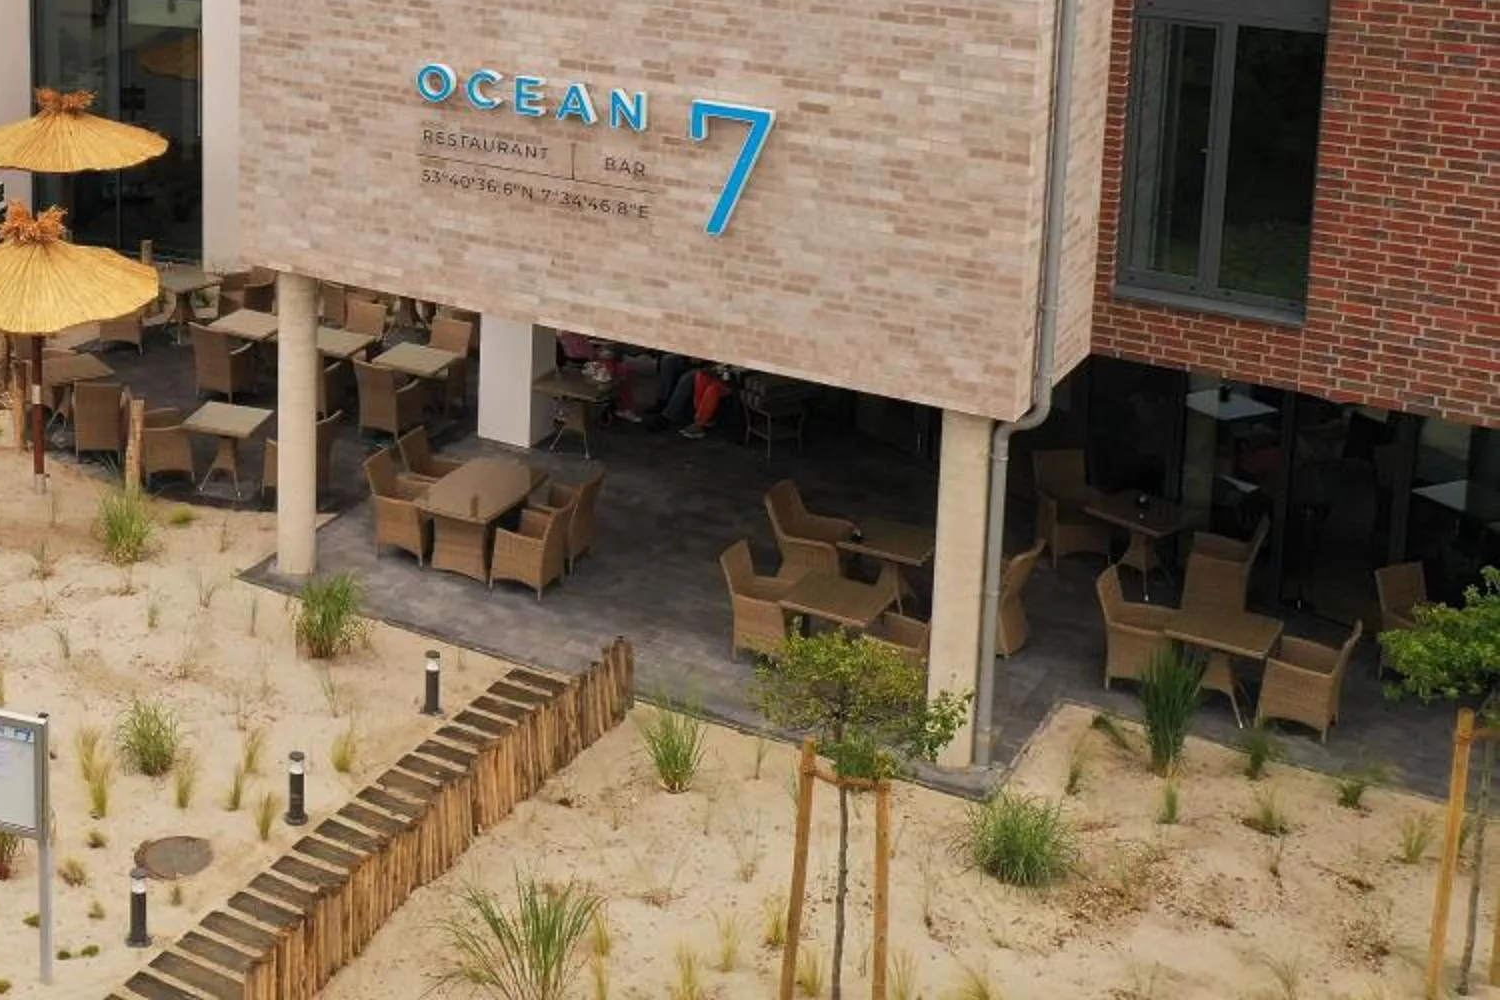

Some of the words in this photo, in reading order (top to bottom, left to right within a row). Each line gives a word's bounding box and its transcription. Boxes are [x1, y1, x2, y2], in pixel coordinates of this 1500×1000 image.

[416, 63, 649, 132] OCEAN
[687, 98, 776, 237] 7
[422, 128, 549, 160] RESTAURANT
[603, 156, 647, 178] BAR
